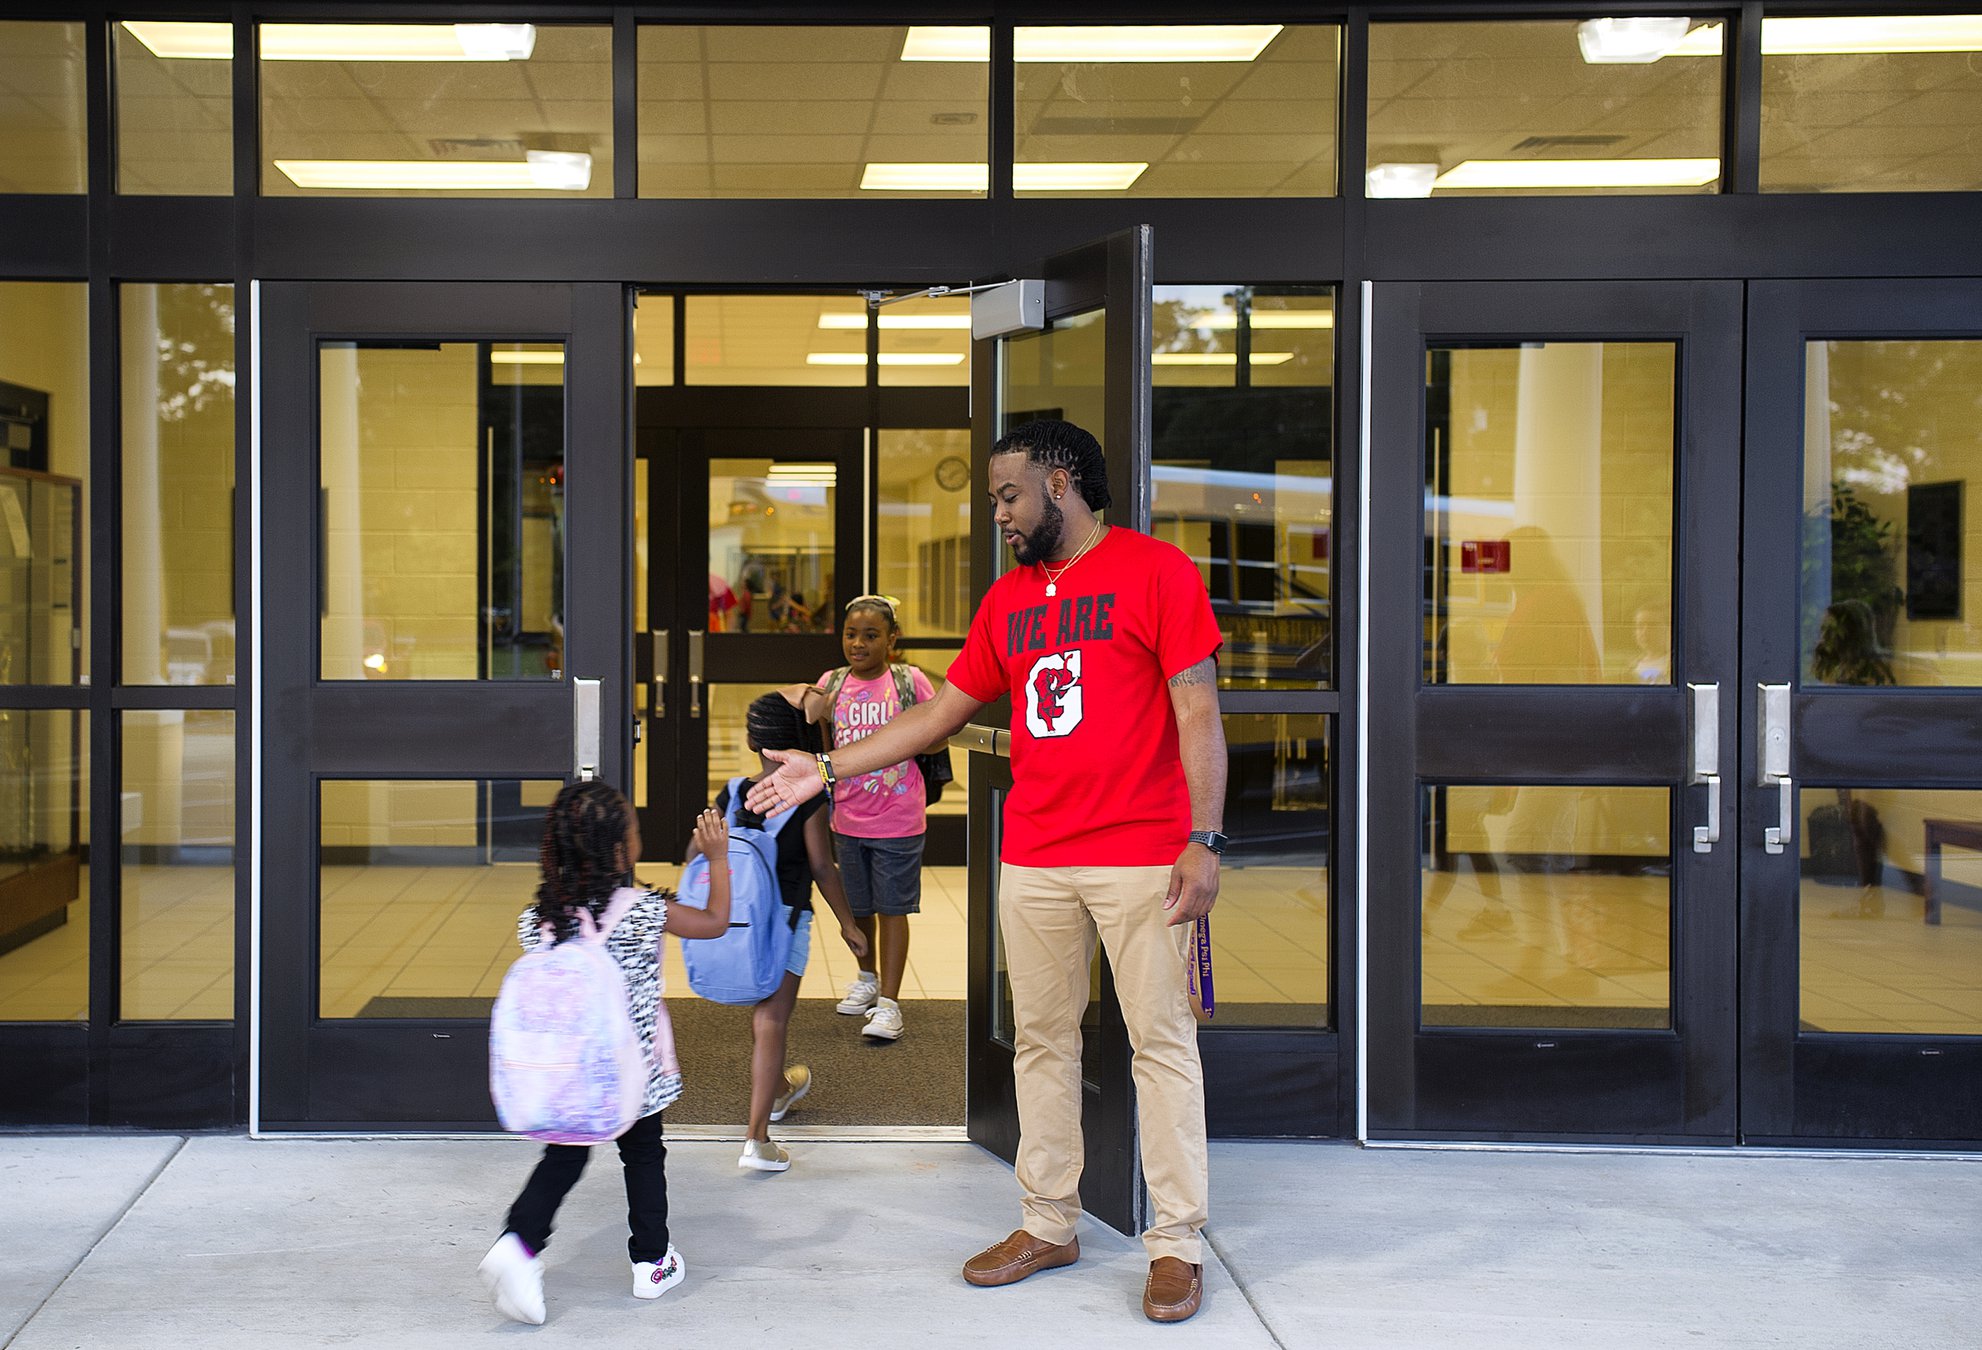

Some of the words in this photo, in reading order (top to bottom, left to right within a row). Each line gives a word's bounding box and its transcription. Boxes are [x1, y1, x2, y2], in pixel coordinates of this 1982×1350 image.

[1007, 604, 1048, 657] WE
[1056, 593, 1116, 647] ARE
[848, 701, 888, 726] GIRL
[1025, 649, 1083, 739] G
